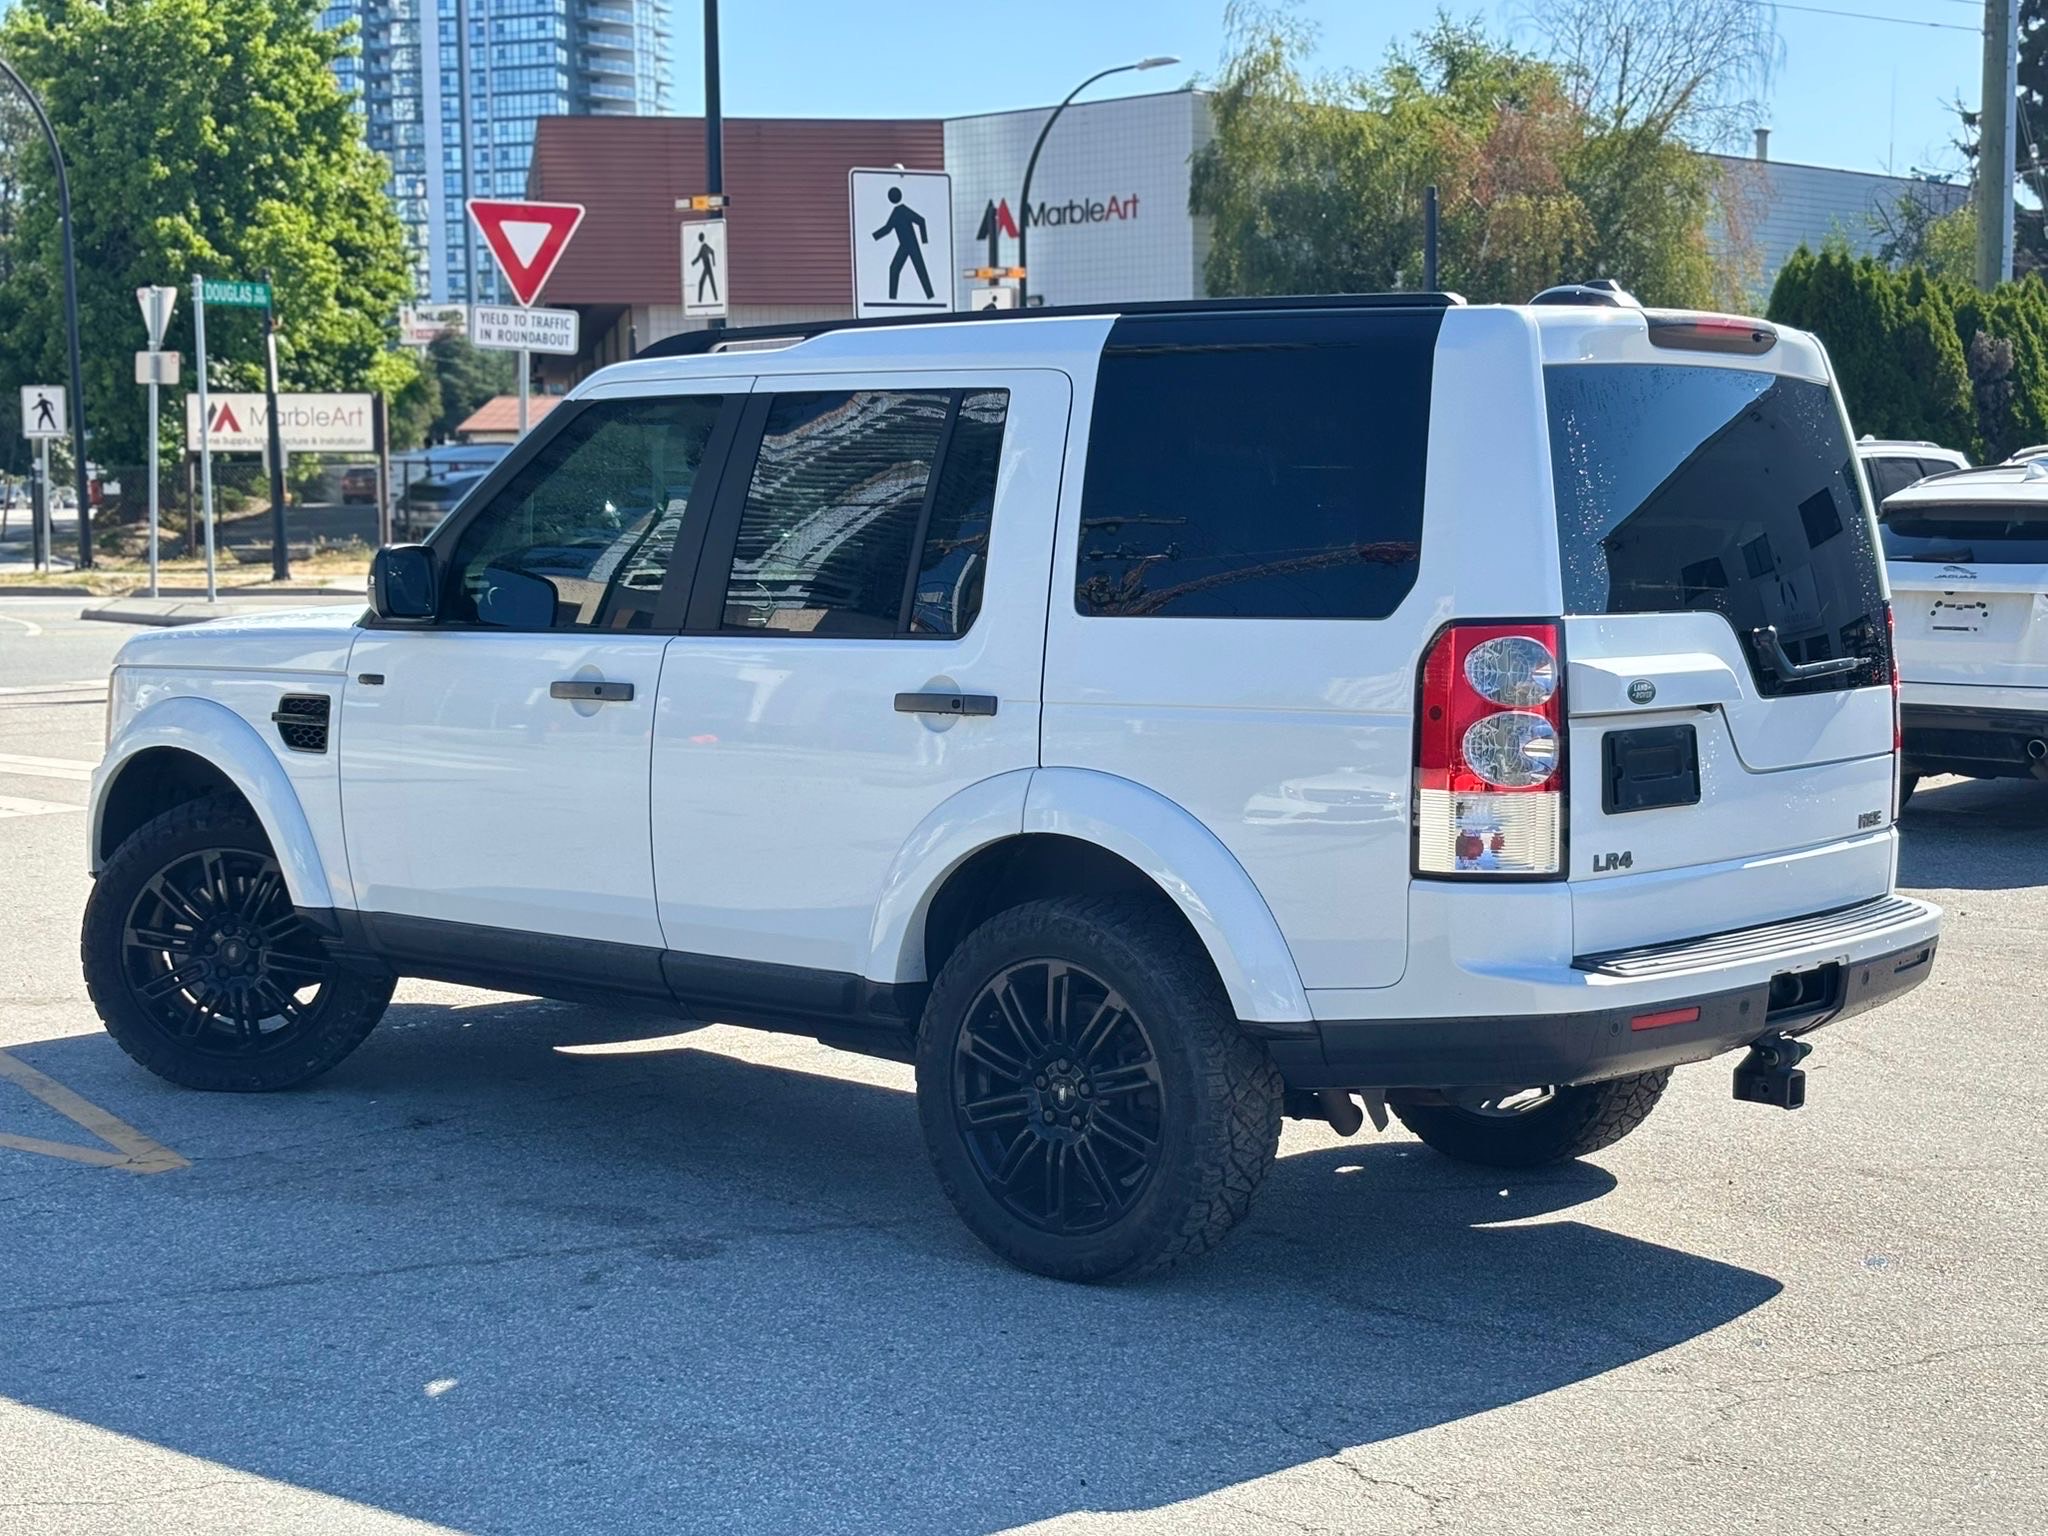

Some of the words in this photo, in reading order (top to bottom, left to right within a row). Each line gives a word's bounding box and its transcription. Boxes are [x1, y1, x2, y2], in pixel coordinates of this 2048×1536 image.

[1025, 193, 1140, 228] MarbleArt
[205, 283, 254, 303] DOUGLAS
[480, 312, 509, 326] YIELD
[513, 314, 527, 327] TO
[531, 315, 571, 330] TRAFFIC
[480, 329, 492, 340] IN
[497, 330, 570, 346] ROUNDABOUT
[250, 406, 364, 427] MarbleArt
[1592, 850, 1634, 873] LR4
